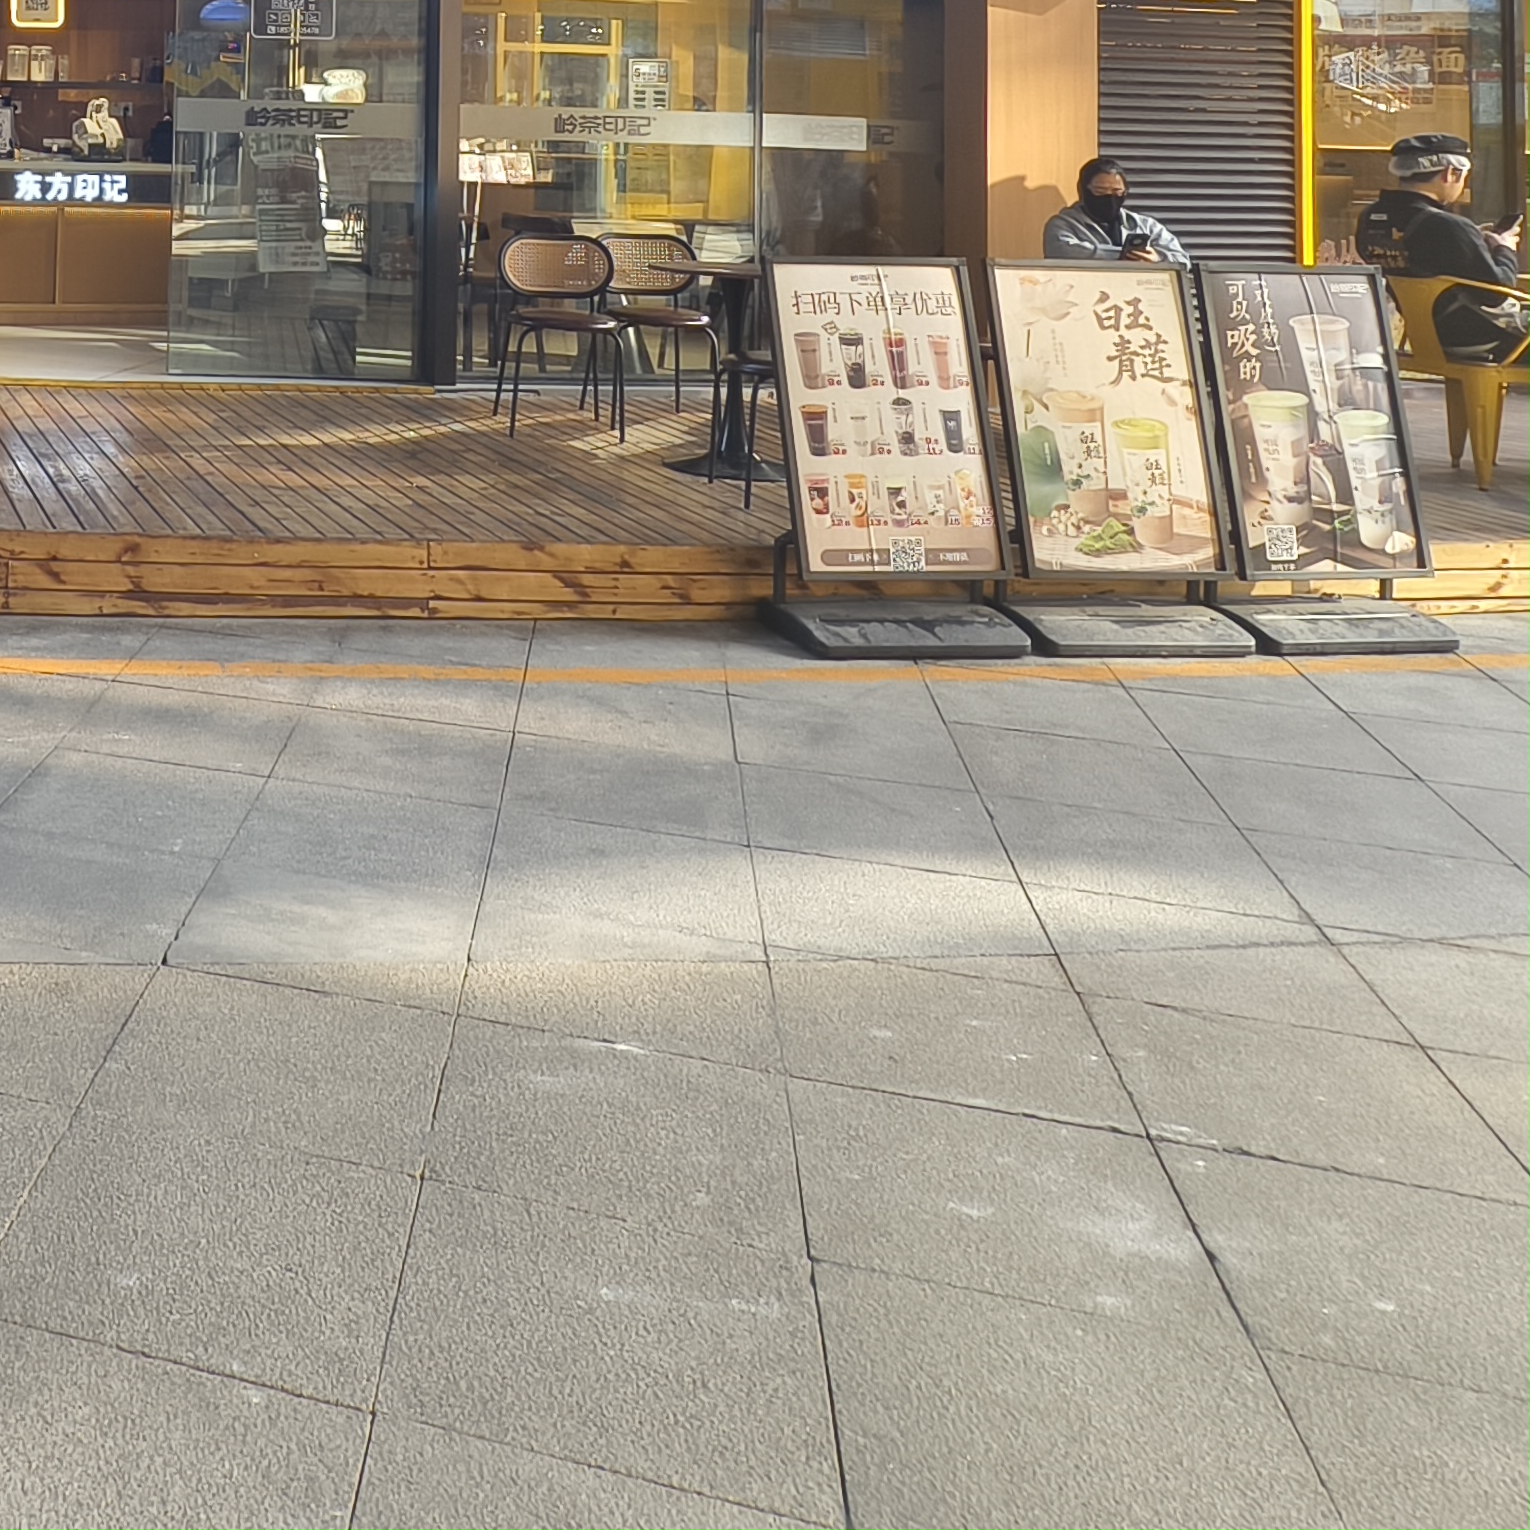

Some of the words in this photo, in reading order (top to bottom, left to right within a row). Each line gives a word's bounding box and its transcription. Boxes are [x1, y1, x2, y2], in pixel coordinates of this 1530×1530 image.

[14, 171, 128, 202] 东方印记
[791, 290, 957, 317] 扫码下单享优惠
[1093, 291, 1153, 332] 白玉
[1225, 280, 1261, 383] 可以吸的
[1106, 332, 1179, 387] 青莲
